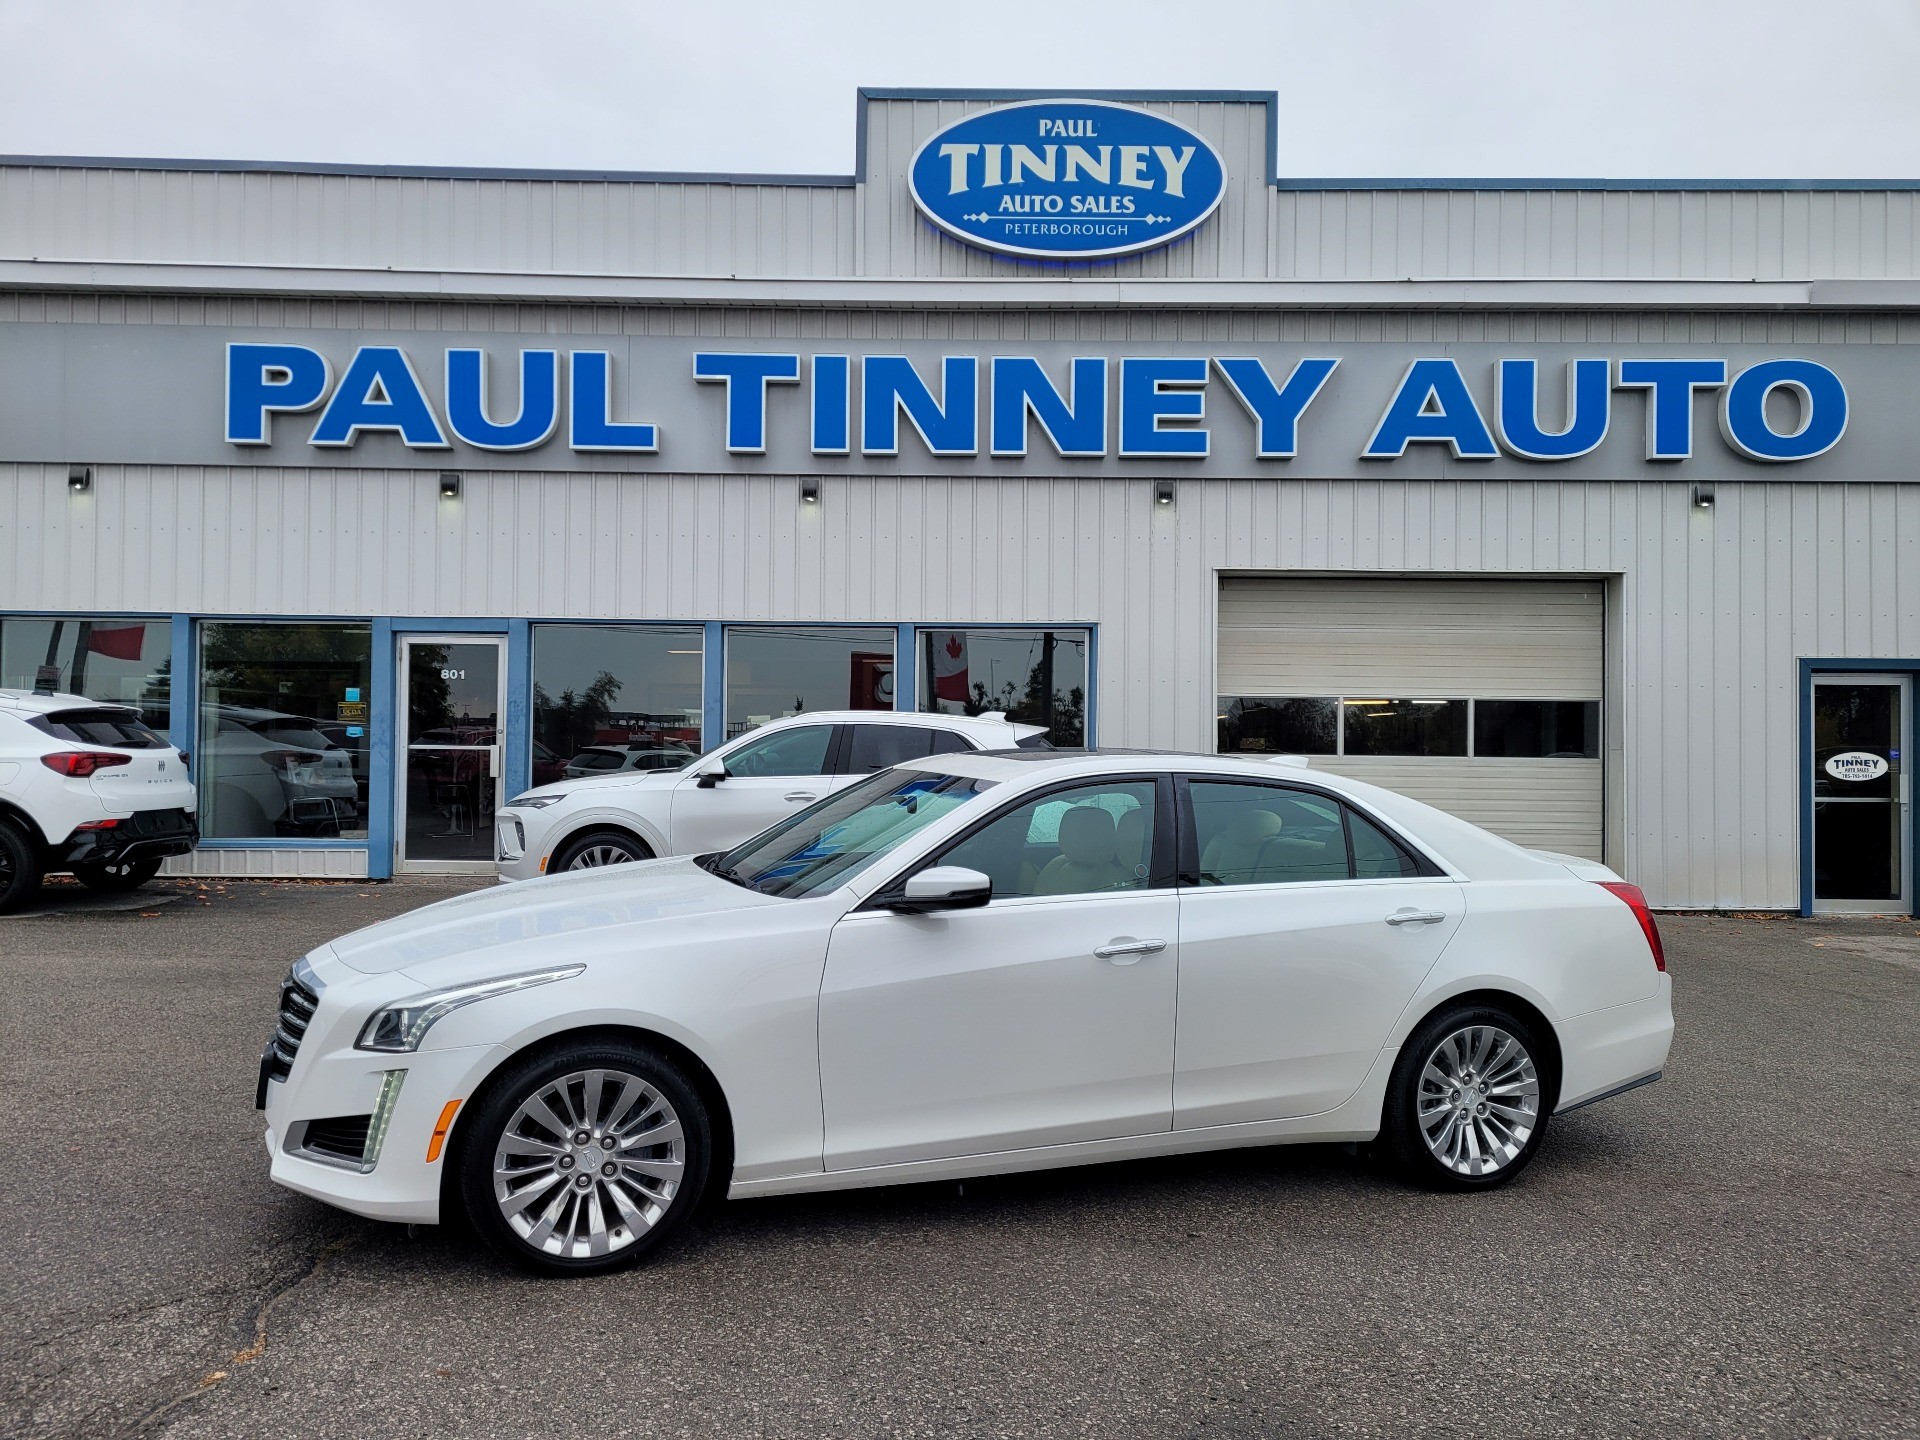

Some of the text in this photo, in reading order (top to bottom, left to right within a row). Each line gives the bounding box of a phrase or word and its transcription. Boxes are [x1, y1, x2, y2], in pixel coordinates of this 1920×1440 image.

[1039, 119, 1098, 137] PAUL
[938, 143, 1197, 199] TINNEY
[998, 194, 1136, 214] AUTO SALES
[1004, 223, 1129, 236] PETERBOROUGH
[224, 342, 1851, 463] PAUL TINNEY AUTO
[440, 669, 465, 680] 801
[1833, 759, 1880, 769] TINNEY
